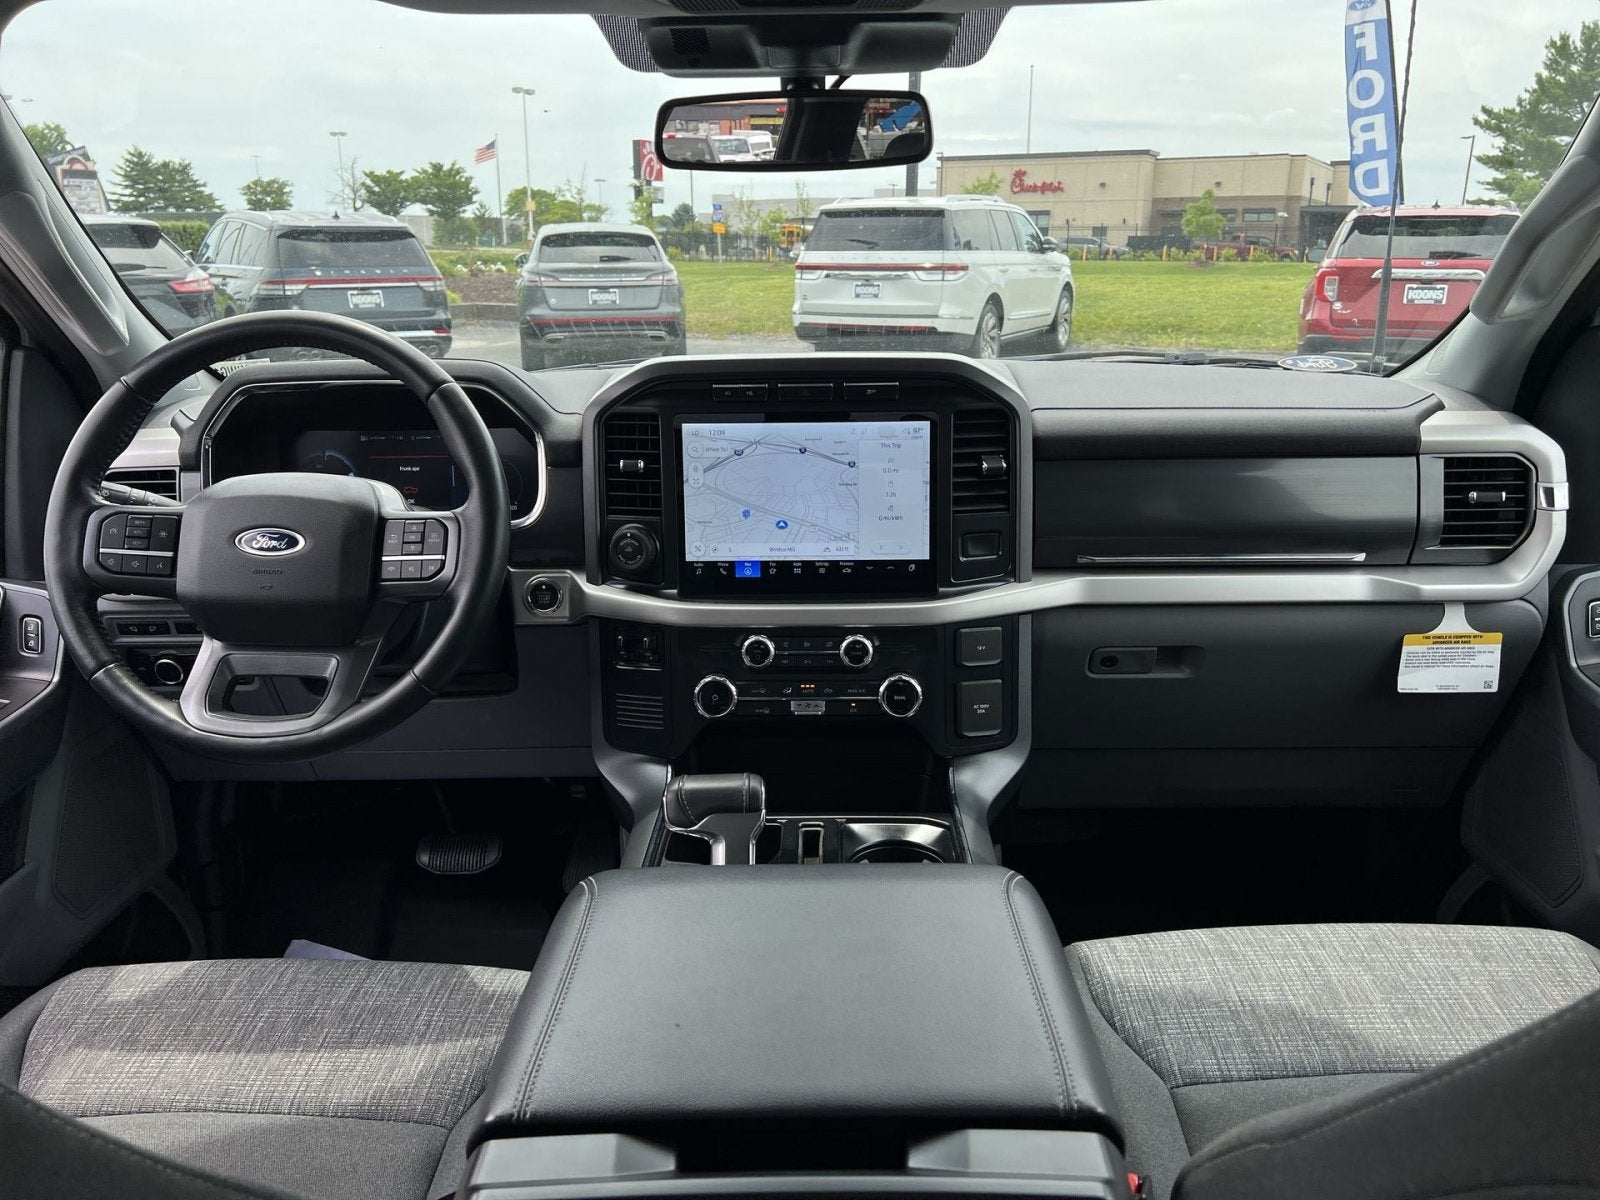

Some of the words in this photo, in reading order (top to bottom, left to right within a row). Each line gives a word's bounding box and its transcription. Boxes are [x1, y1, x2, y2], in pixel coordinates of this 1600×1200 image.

[1407, 289, 1444, 299] KOONS
[892, 442, 903, 450] Trip
[252, 533, 288, 549] Ford
